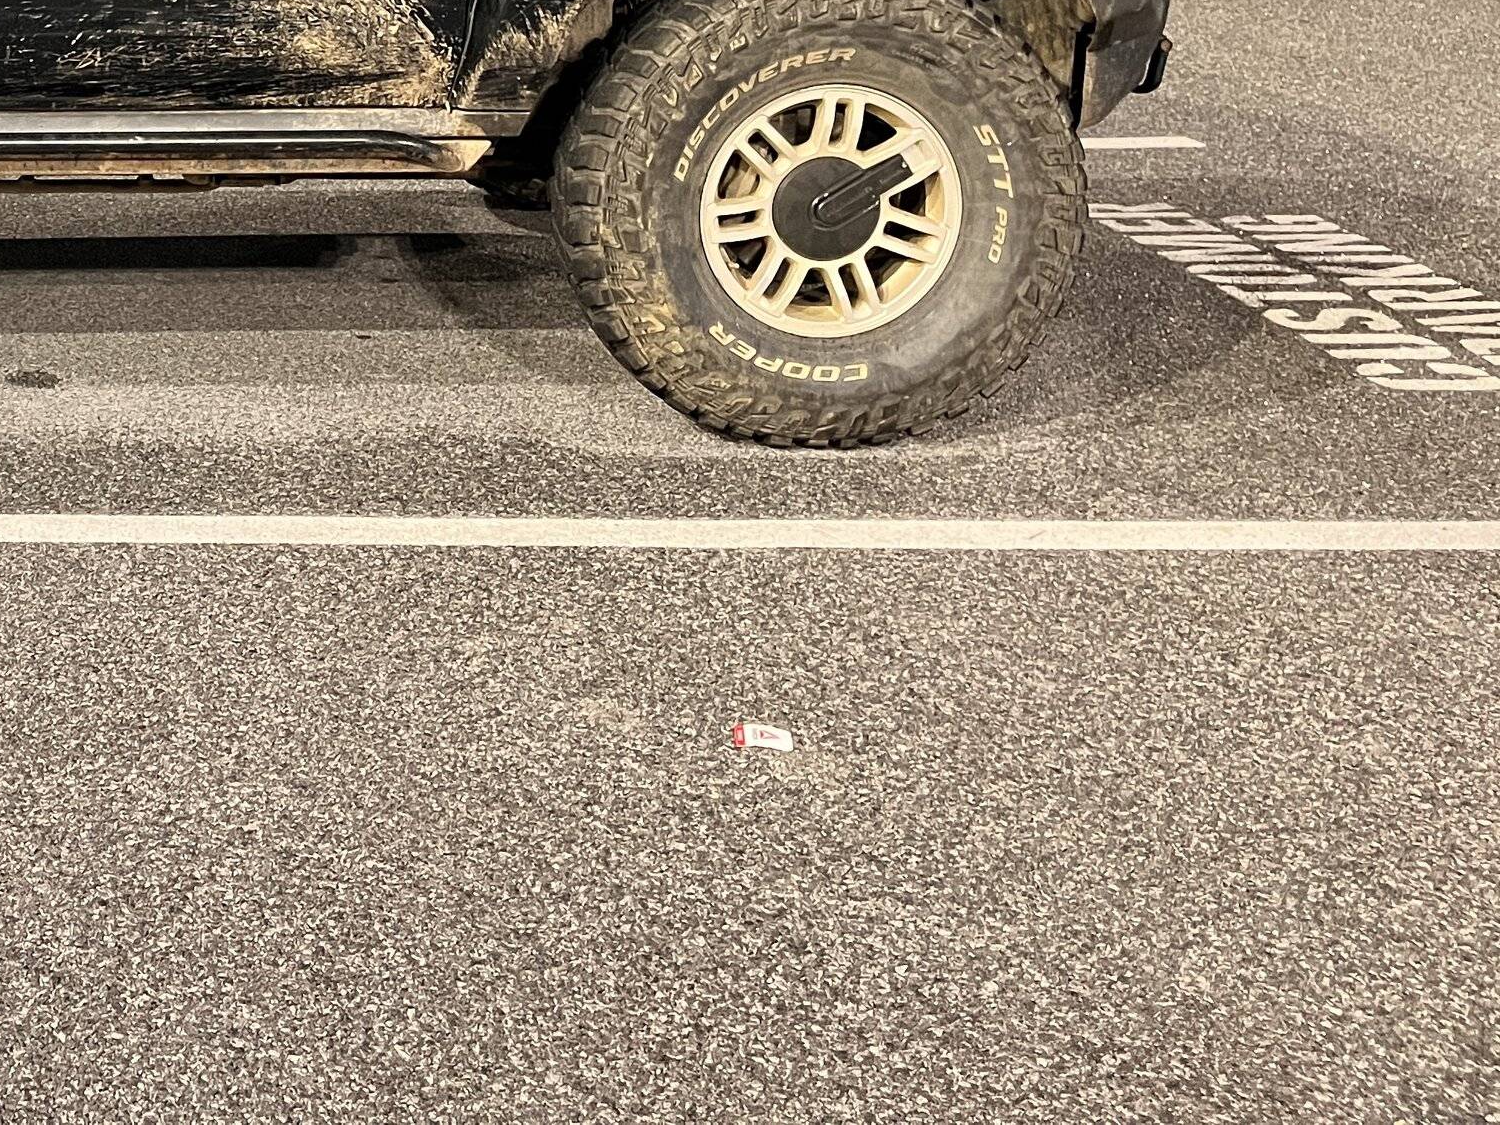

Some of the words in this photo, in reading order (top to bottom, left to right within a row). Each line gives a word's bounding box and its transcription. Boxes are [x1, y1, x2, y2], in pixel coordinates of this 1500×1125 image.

[673, 47, 857, 182] DISCOVERER
[972, 124, 1014, 199] STT
[987, 205, 1008, 264] PRO
[1088, 202, 1500, 392] CUSTOMER
[1220, 214, 1500, 367] ARKING
[707, 320, 869, 383] COOPER
